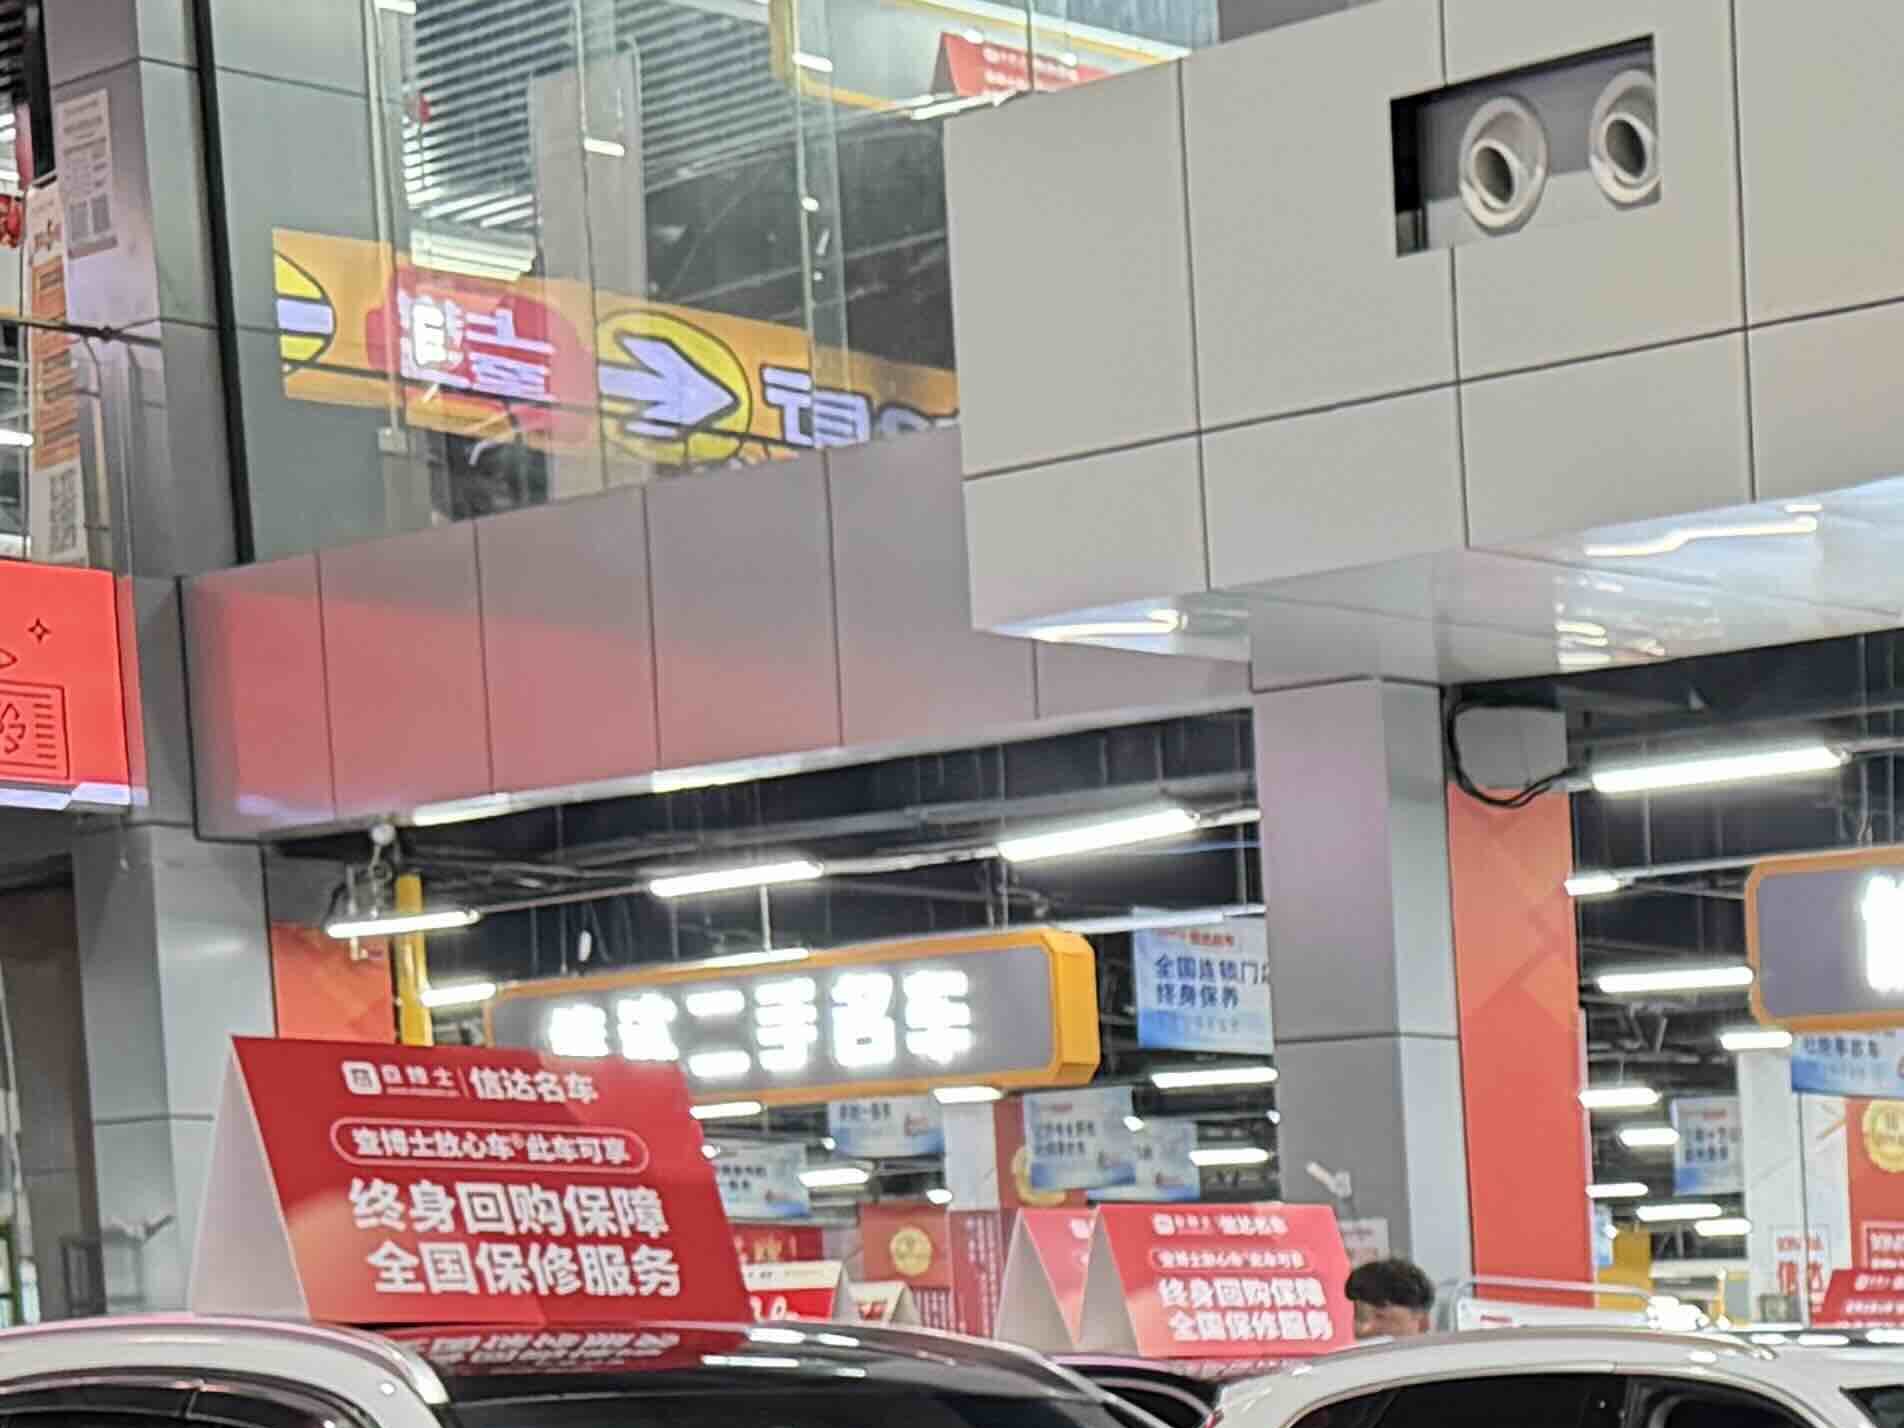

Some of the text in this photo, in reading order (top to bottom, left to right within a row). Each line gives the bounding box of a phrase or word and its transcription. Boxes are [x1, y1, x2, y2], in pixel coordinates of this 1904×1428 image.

[470, 1066, 599, 1104] 信达名车
[348, 1177, 671, 1239] 终身回购保障
[366, 1239, 682, 1298] 全国保修服务
[1156, 1276, 1328, 1309] 终身回购保障
[1168, 1310, 1335, 1342] 全国保修服务
